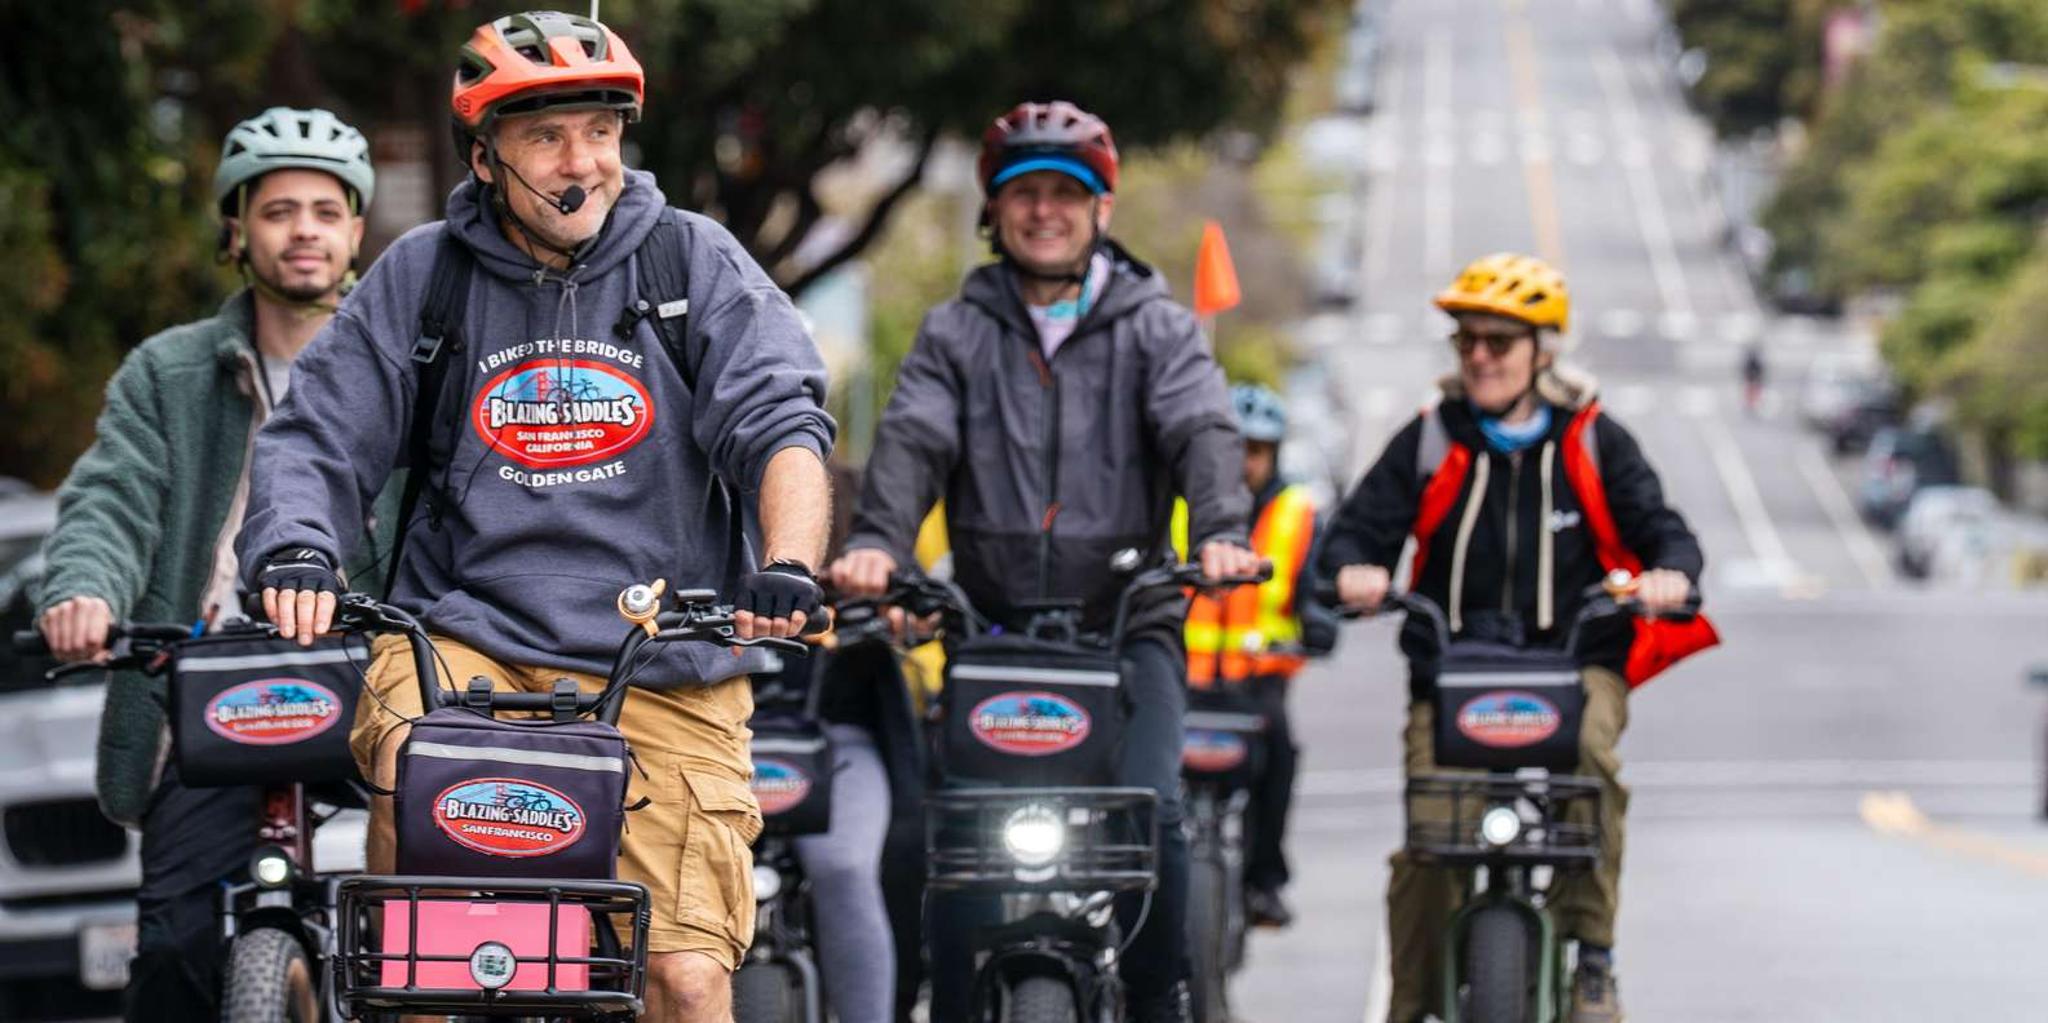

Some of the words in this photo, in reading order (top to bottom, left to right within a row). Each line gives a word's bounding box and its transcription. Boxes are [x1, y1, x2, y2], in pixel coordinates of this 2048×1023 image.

[478, 360, 489, 374] I
[535, 339, 572, 354] THE
[574, 339, 644, 369] BRIDGE
[490, 398, 559, 428] BLAZING
[562, 396, 636, 426] SADDLES
[499, 466, 573, 487] GOLDEN
[575, 460, 627, 482] GATE
[446, 799, 510, 822] BLAZING
[512, 808, 573, 832] SADDLES
[461, 823, 488, 835] SAN
[488, 826, 553, 842] FRANCISCO
